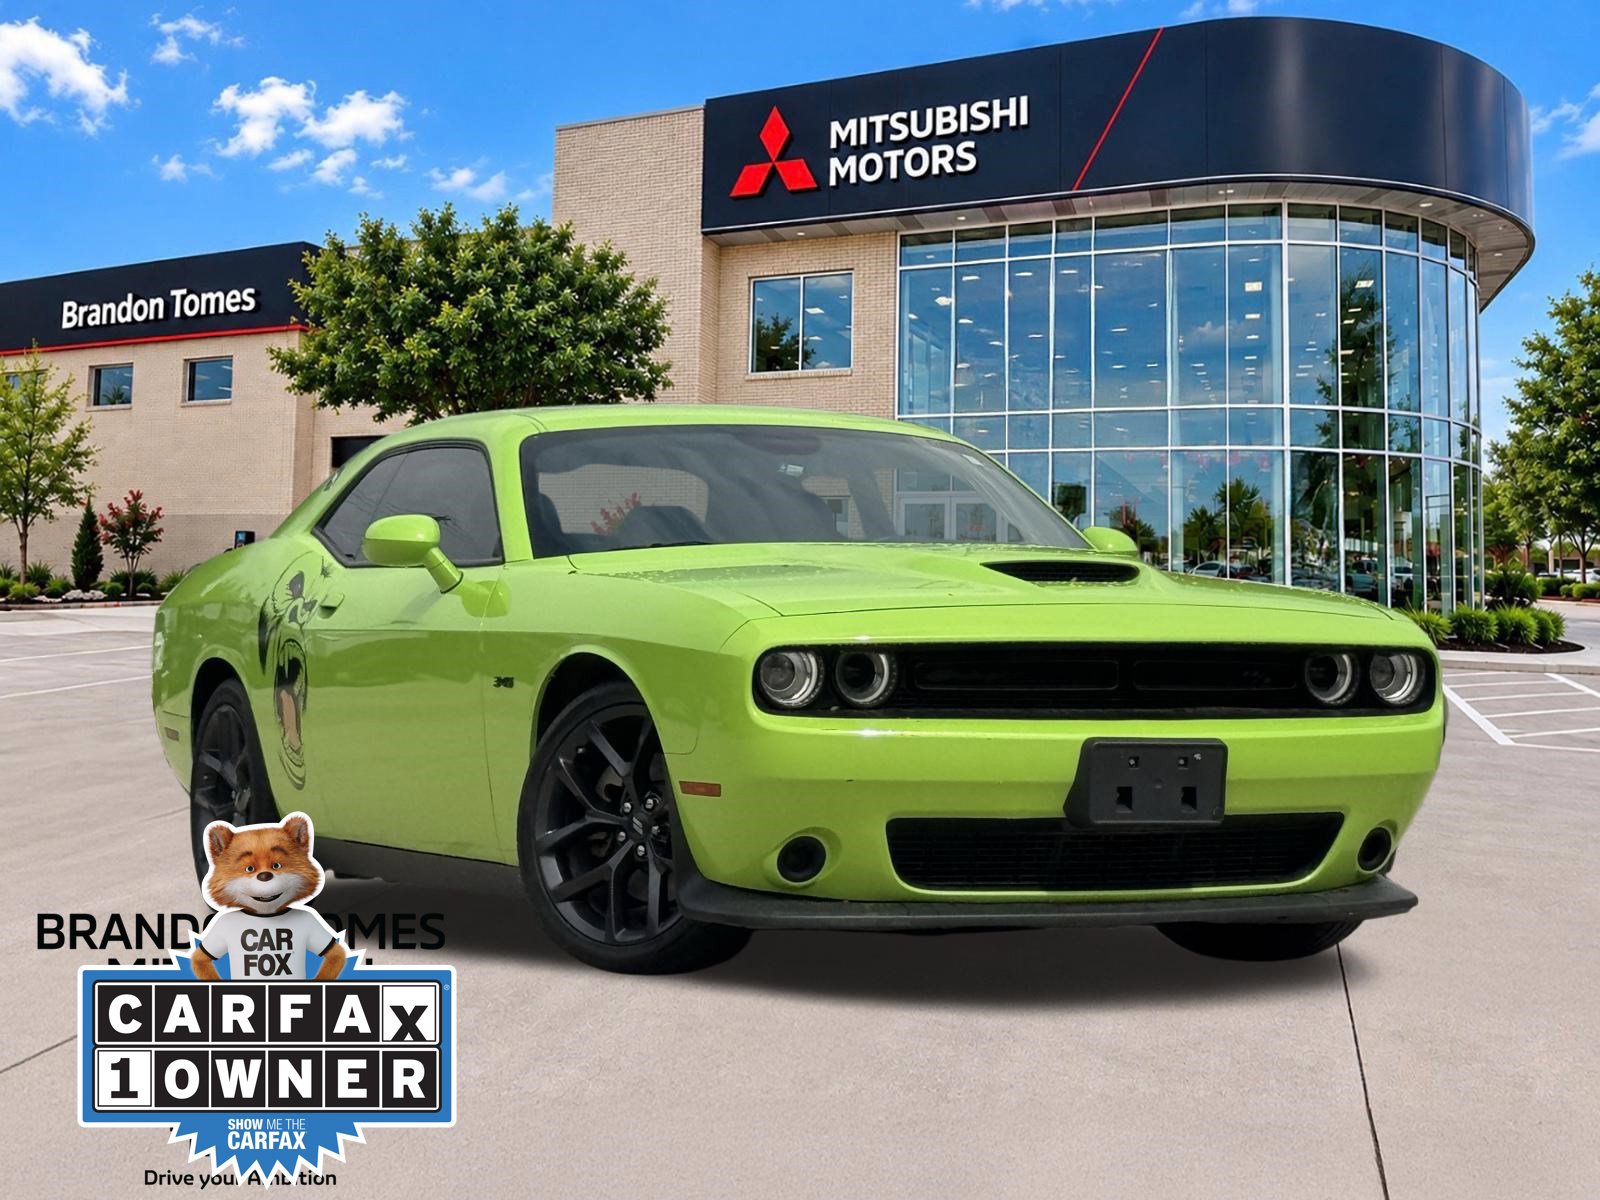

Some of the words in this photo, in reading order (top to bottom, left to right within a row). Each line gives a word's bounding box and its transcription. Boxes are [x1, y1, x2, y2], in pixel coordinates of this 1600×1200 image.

[830, 95, 1028, 149] MITSUBISHI
[829, 141, 977, 186] MOTORS
[62, 293, 164, 329] Brandon
[170, 288, 256, 318] Tomes
